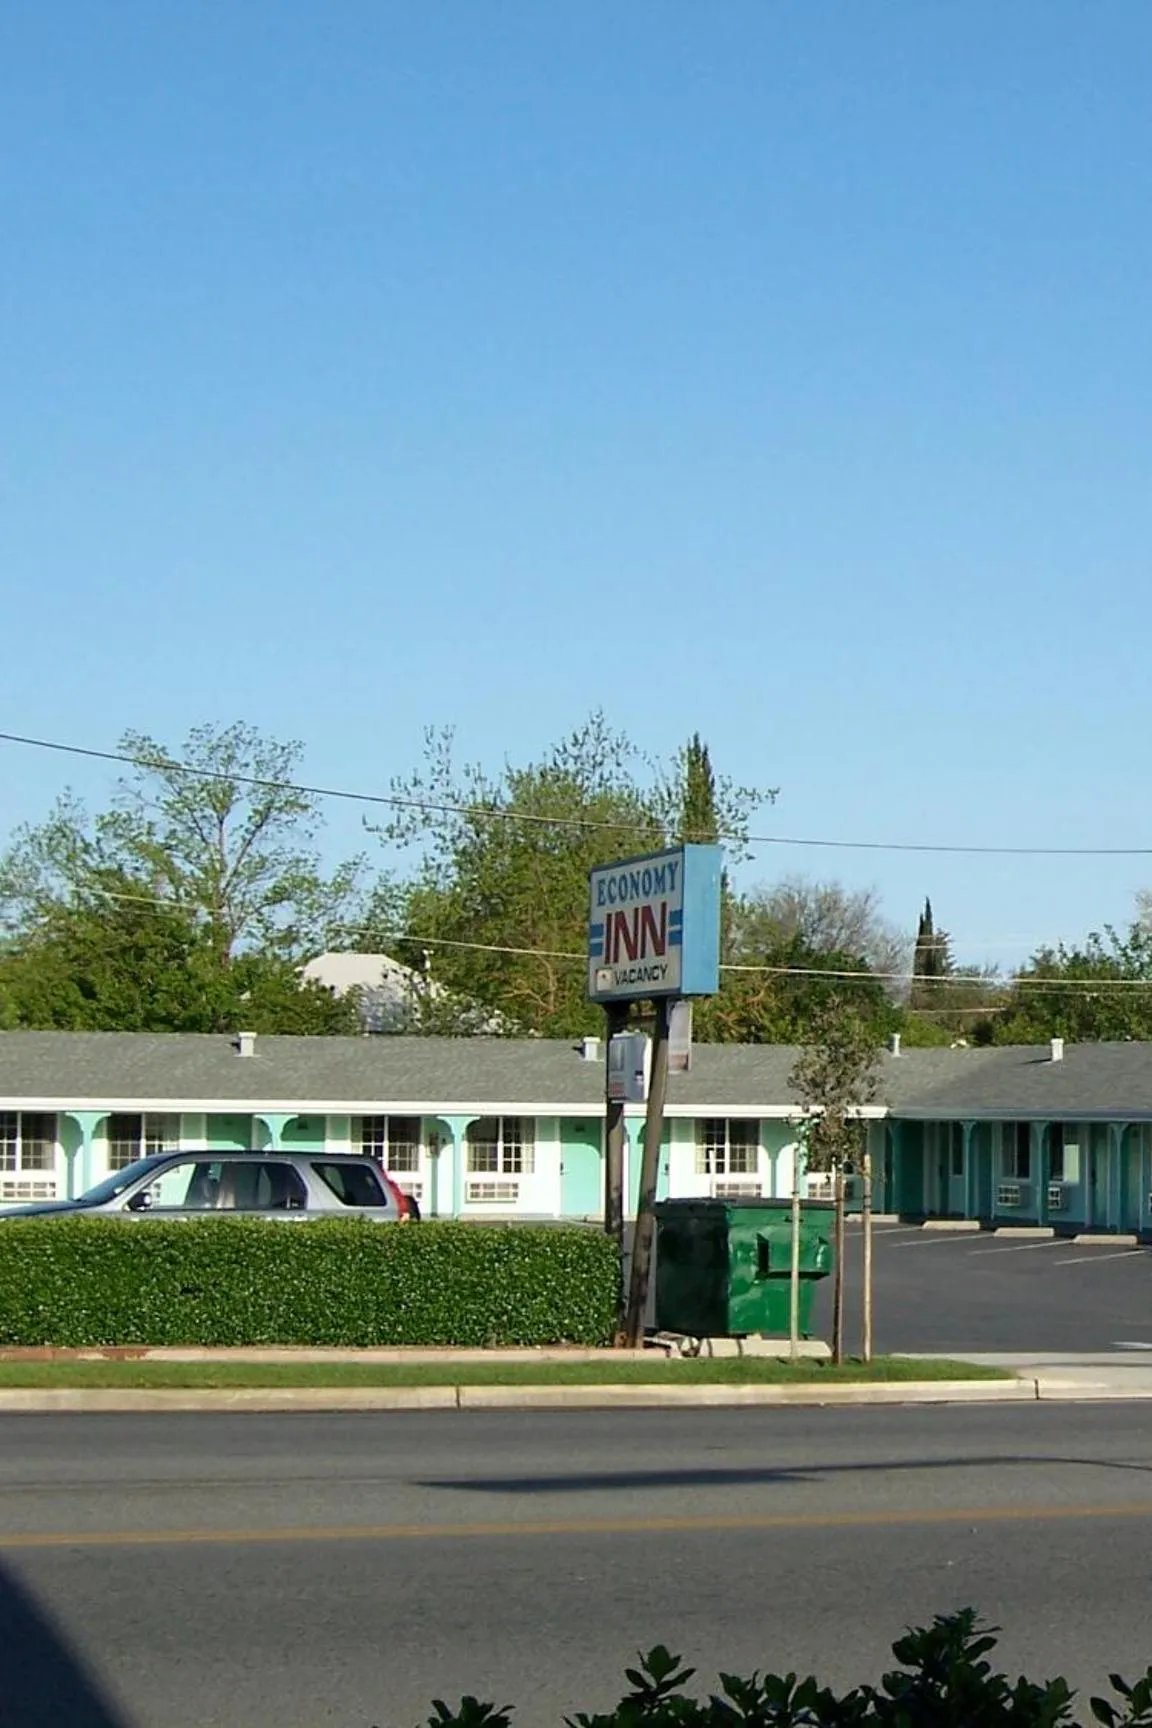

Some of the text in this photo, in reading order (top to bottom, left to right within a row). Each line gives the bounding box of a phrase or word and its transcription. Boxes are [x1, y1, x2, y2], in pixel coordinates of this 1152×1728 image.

[596, 861, 678, 907] ECONOMY
[604, 901, 667, 965] INN
[615, 964, 668, 986] VACANCY
